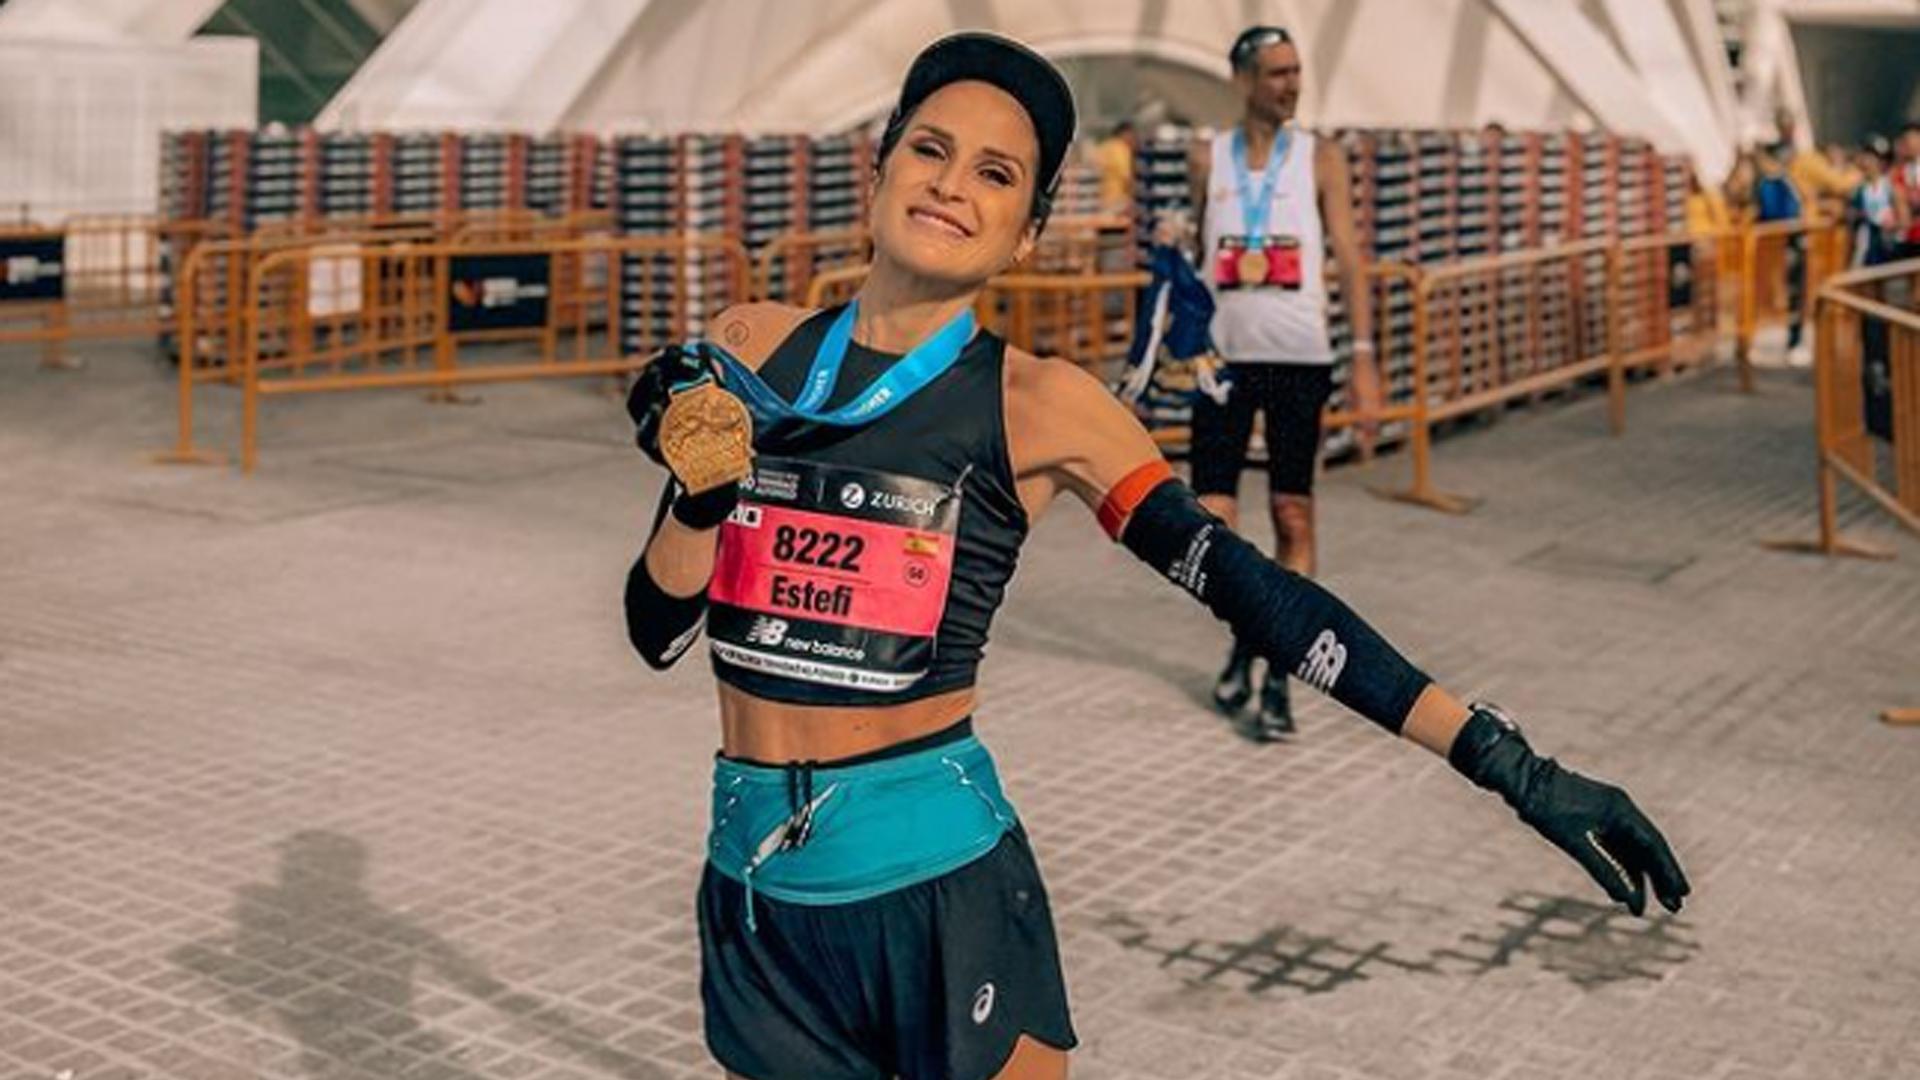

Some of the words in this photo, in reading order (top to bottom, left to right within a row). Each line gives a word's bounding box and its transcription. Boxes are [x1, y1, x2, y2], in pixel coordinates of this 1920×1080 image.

[870, 491, 936, 517] ZURICH
[773, 525, 865, 572] 8222
[770, 576, 853, 617] Estefi
[784, 637, 811, 651] new
[812, 638, 865, 661] balance
